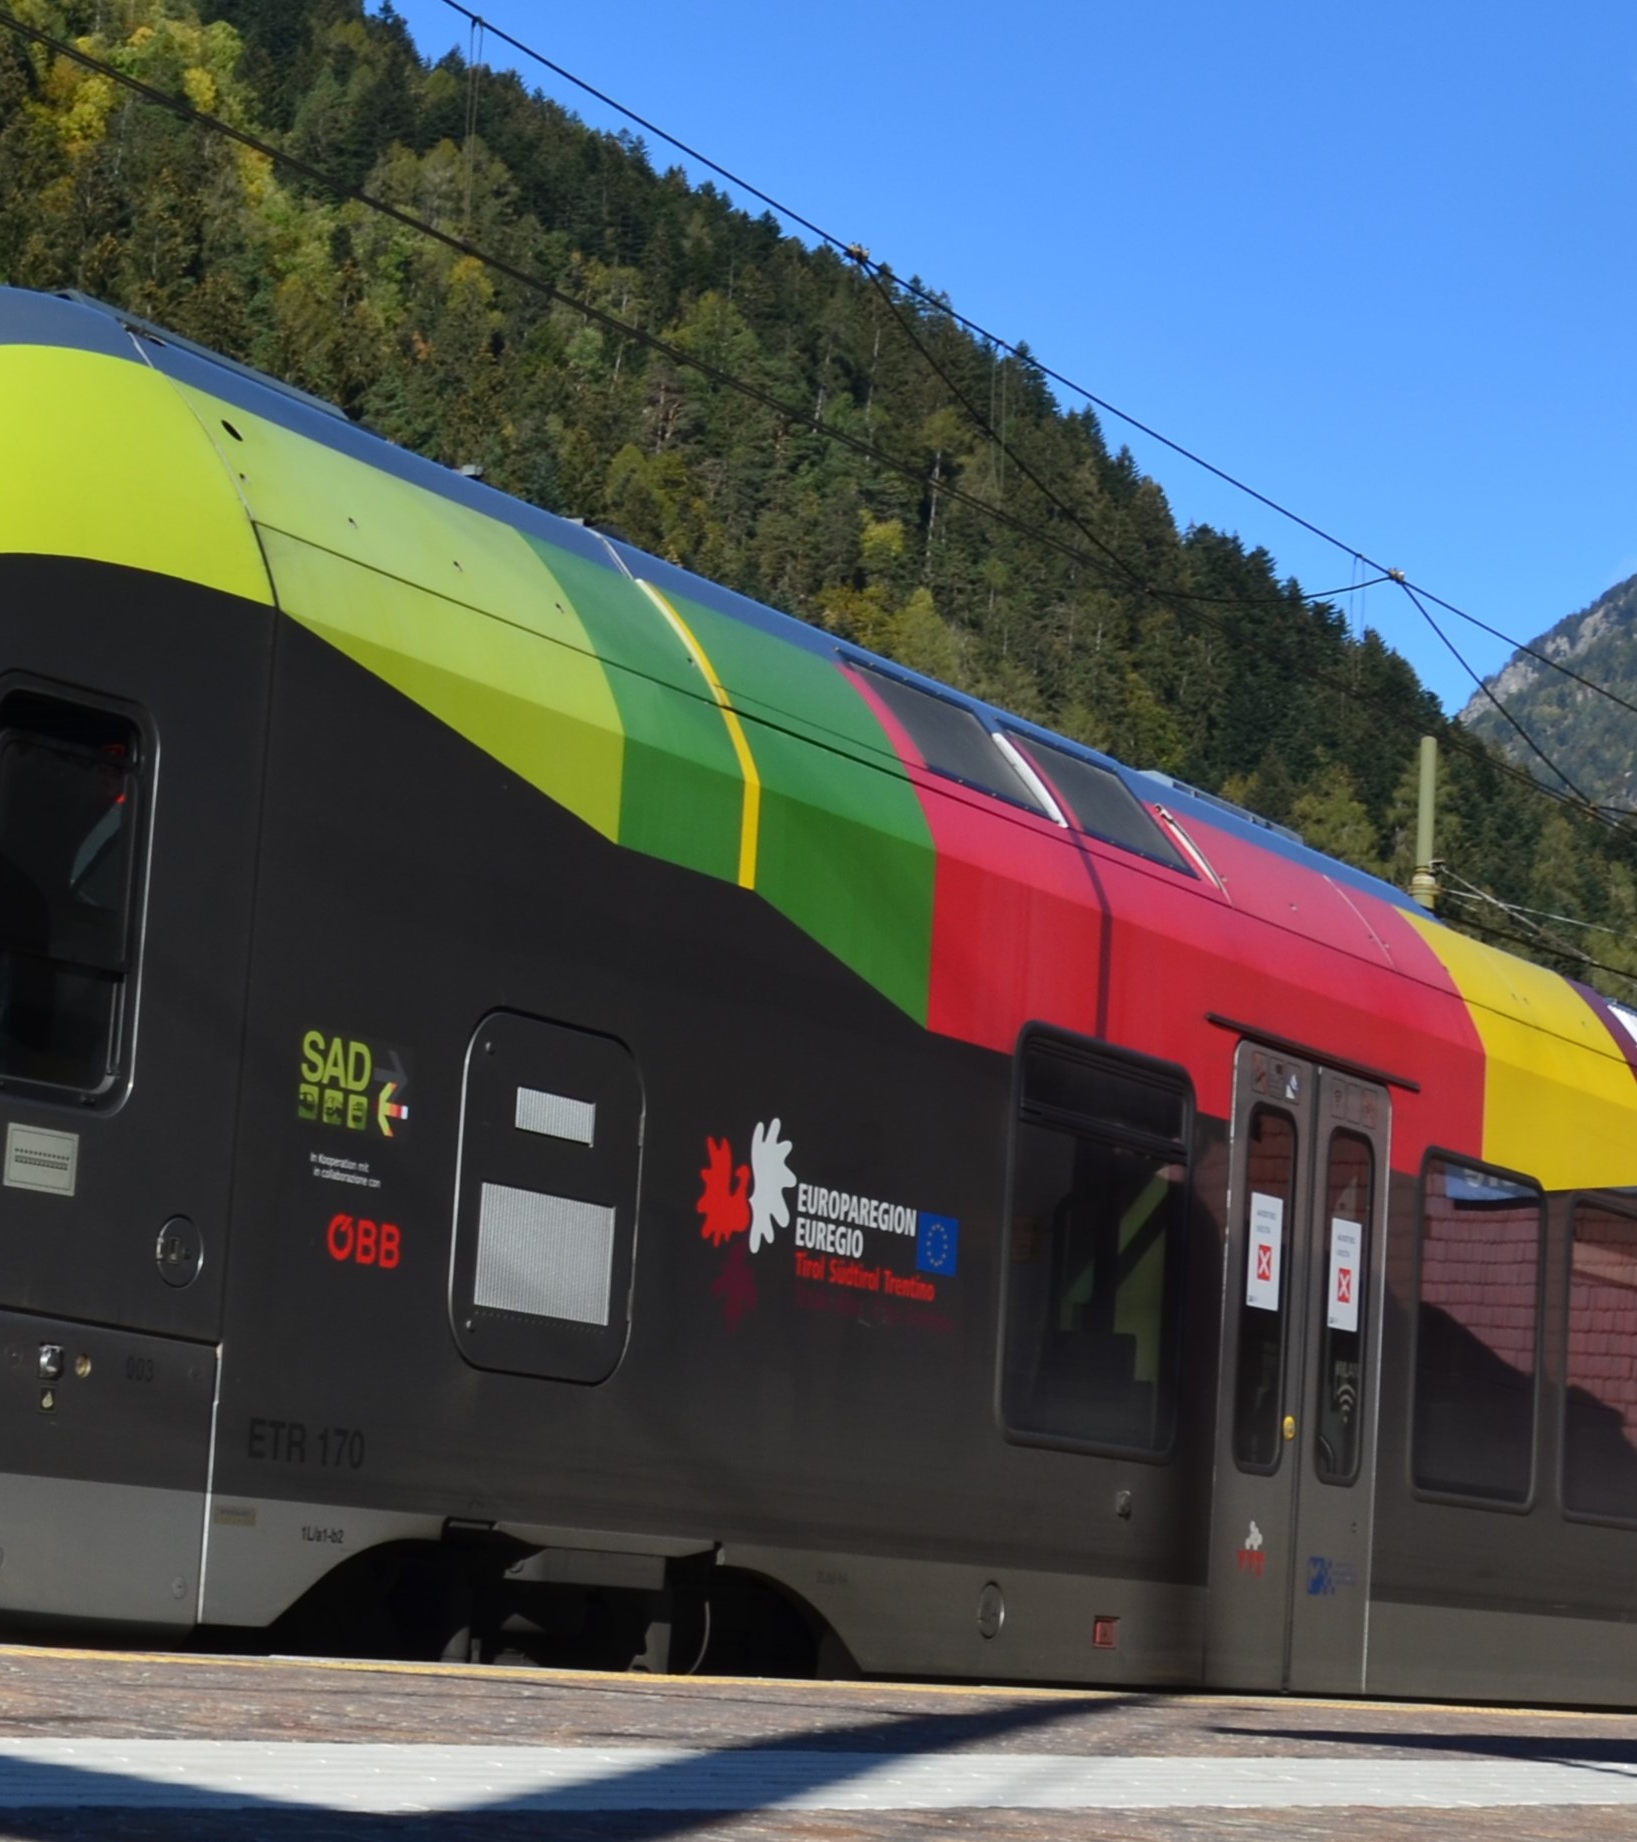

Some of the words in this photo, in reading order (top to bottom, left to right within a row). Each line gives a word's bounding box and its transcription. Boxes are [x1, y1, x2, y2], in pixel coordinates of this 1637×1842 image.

[302, 1030, 371, 1091] SAD
[797, 1183, 917, 1237] EUROPAREGION
[795, 1217, 864, 1258] EUREGIO
[794, 1251, 825, 1280] Tirol
[829, 1258, 880, 1291] Südtirol
[883, 1269, 935, 1302] Trentino
[248, 1417, 306, 1463] ETR
[318, 1427, 365, 1469] 170
